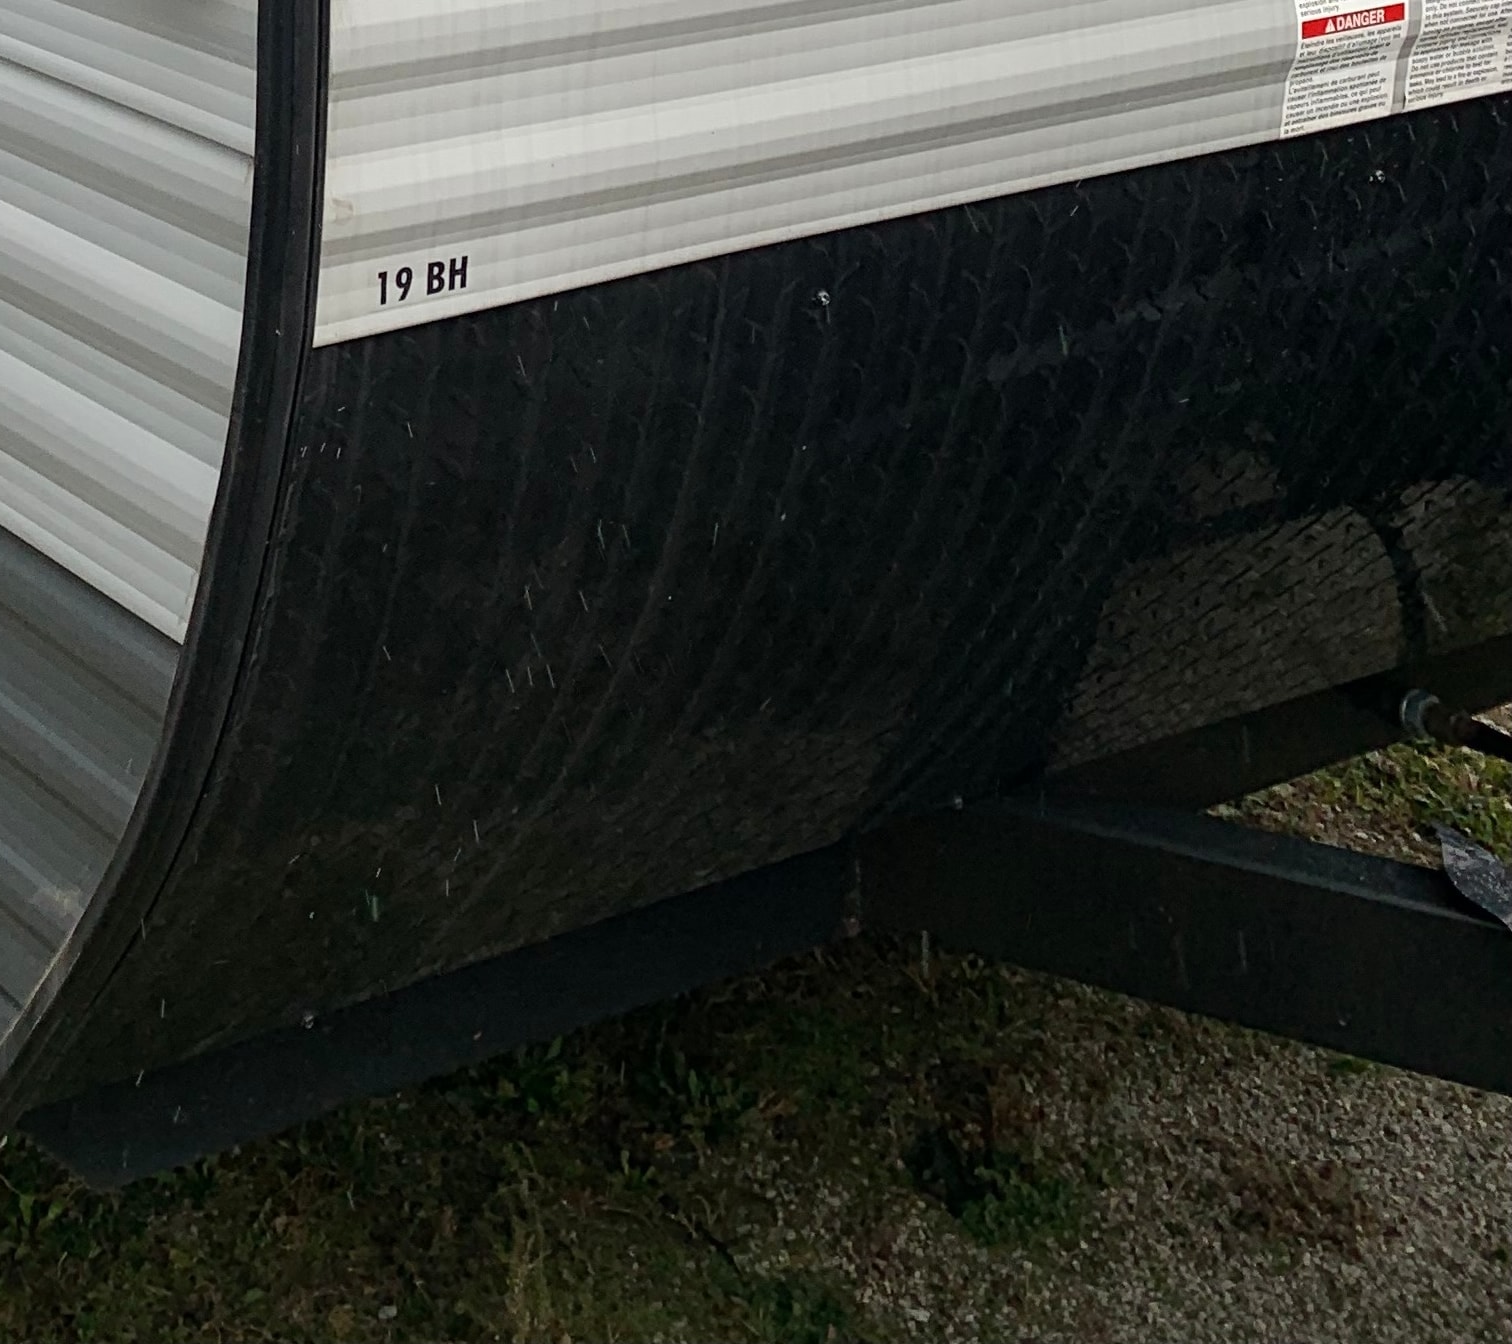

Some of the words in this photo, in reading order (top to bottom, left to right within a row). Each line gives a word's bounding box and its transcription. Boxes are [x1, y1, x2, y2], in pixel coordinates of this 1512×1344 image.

[1337, 9, 1385, 30] DANGER
[378, 266, 413, 305] 19
[426, 255, 468, 296] BH
